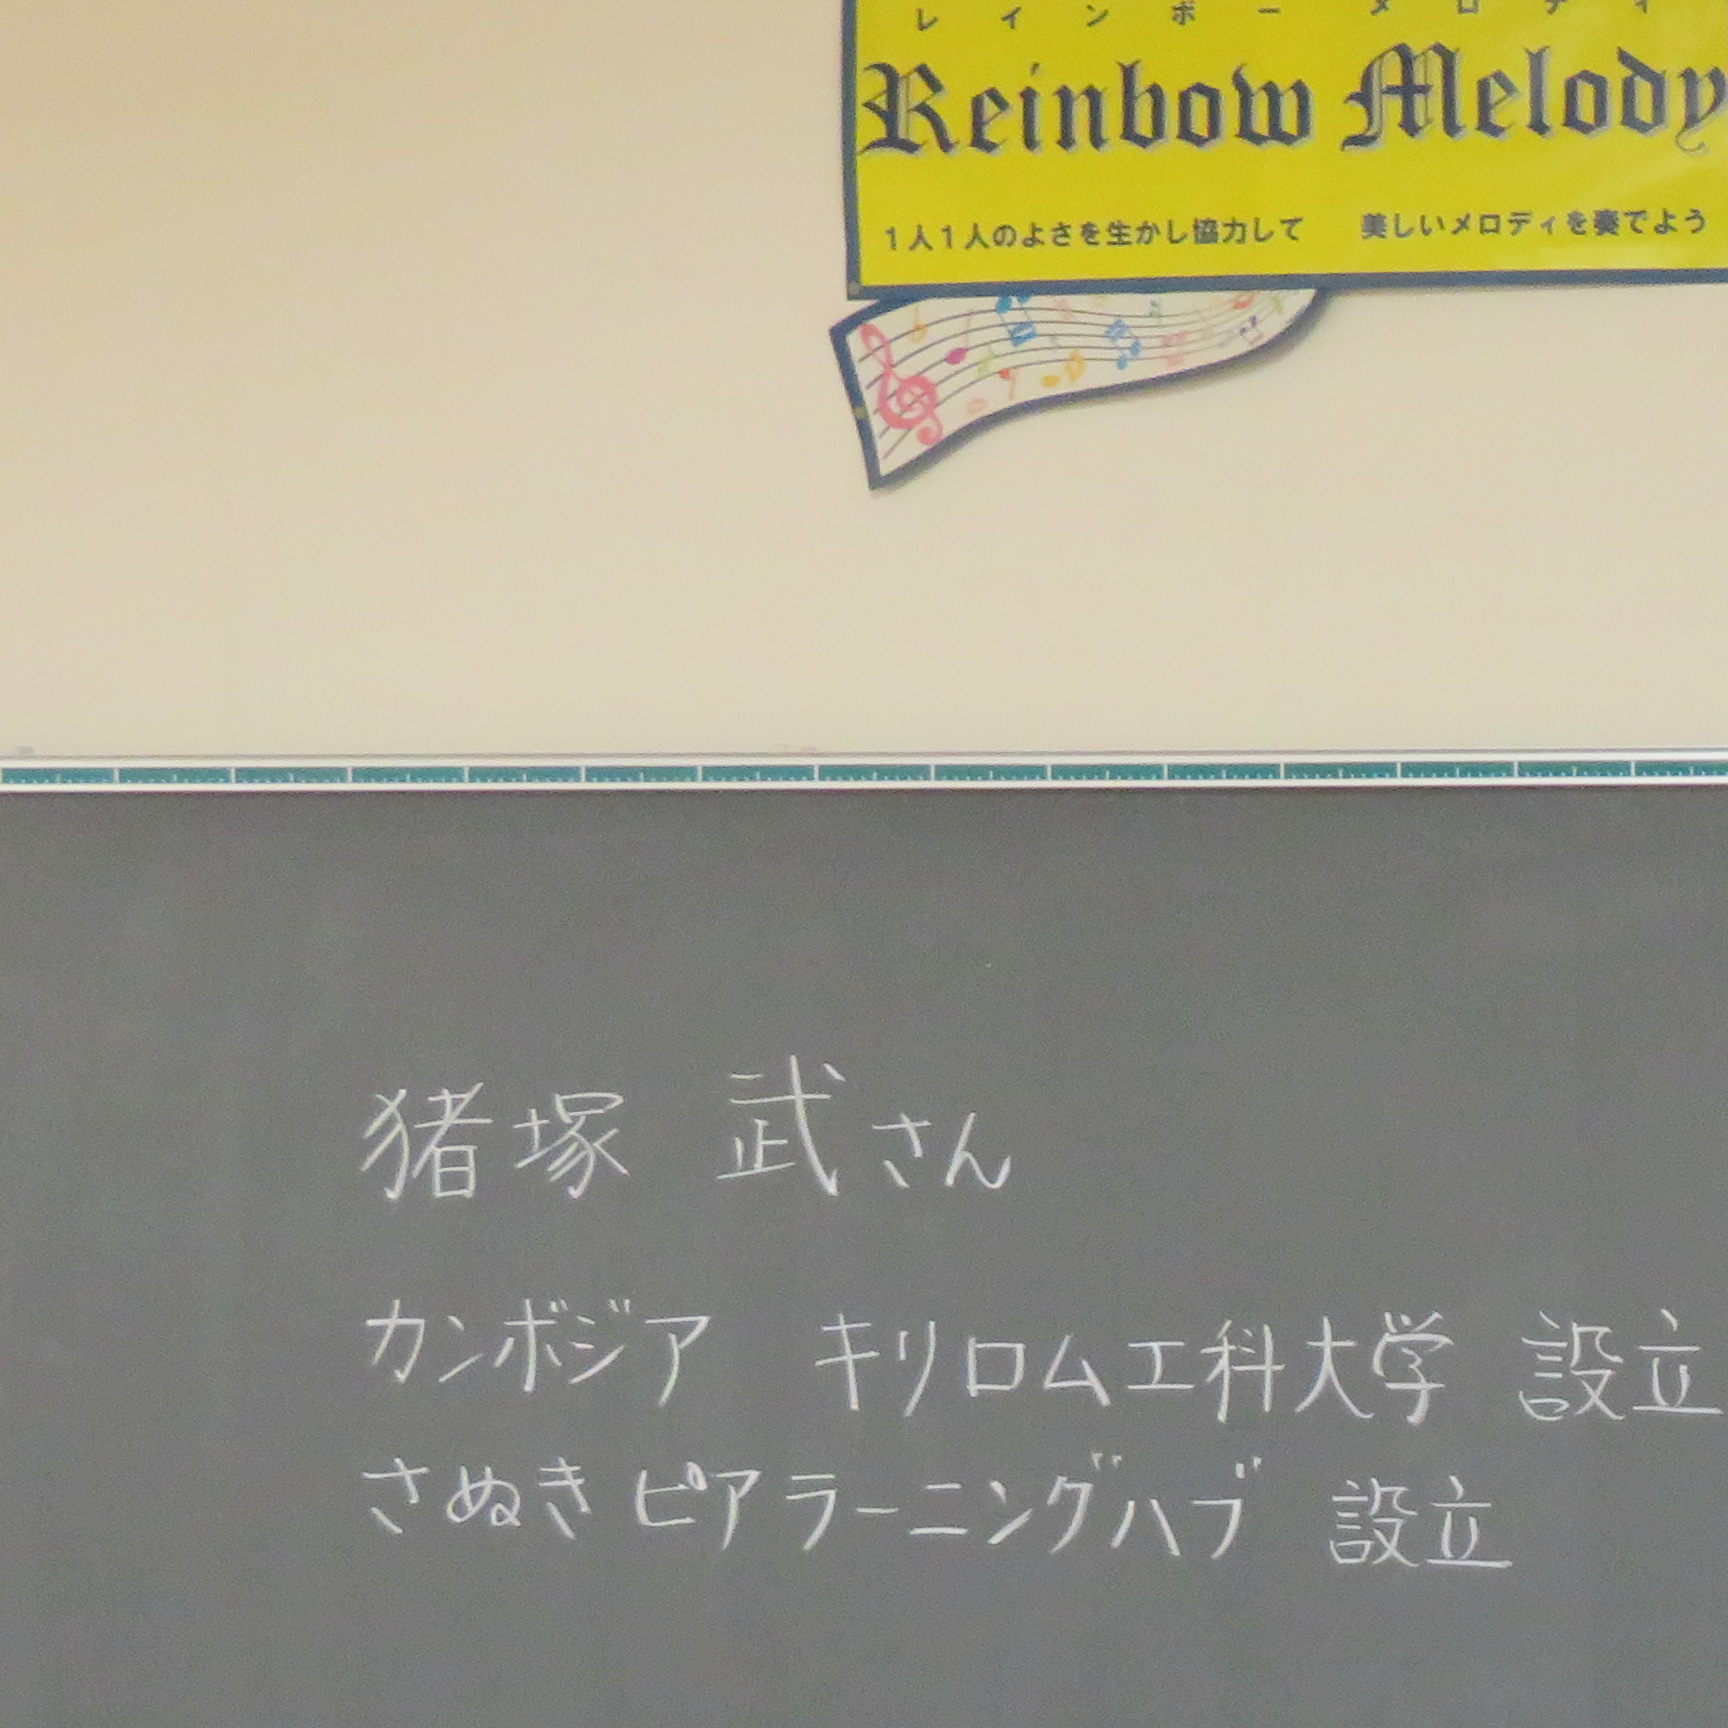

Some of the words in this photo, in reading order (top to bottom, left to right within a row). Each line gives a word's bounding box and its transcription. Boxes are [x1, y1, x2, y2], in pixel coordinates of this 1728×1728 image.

[858, 60, 1312, 156] Reinbow
[1341, 41, 1728, 153] Melody
[1361, 208, 1706, 239] 美しいメロディを奏でよう
[362, 1082, 629, 1200] 猪塚
[717, 1055, 1011, 1196] 武さん
[366, 1299, 711, 1406] カンボジア
[815, 1311, 1454, 1425] キリロム工科大学
[1518, 1309, 1723, 1421] 設立
[1329, 1475, 1512, 1568] 設立
